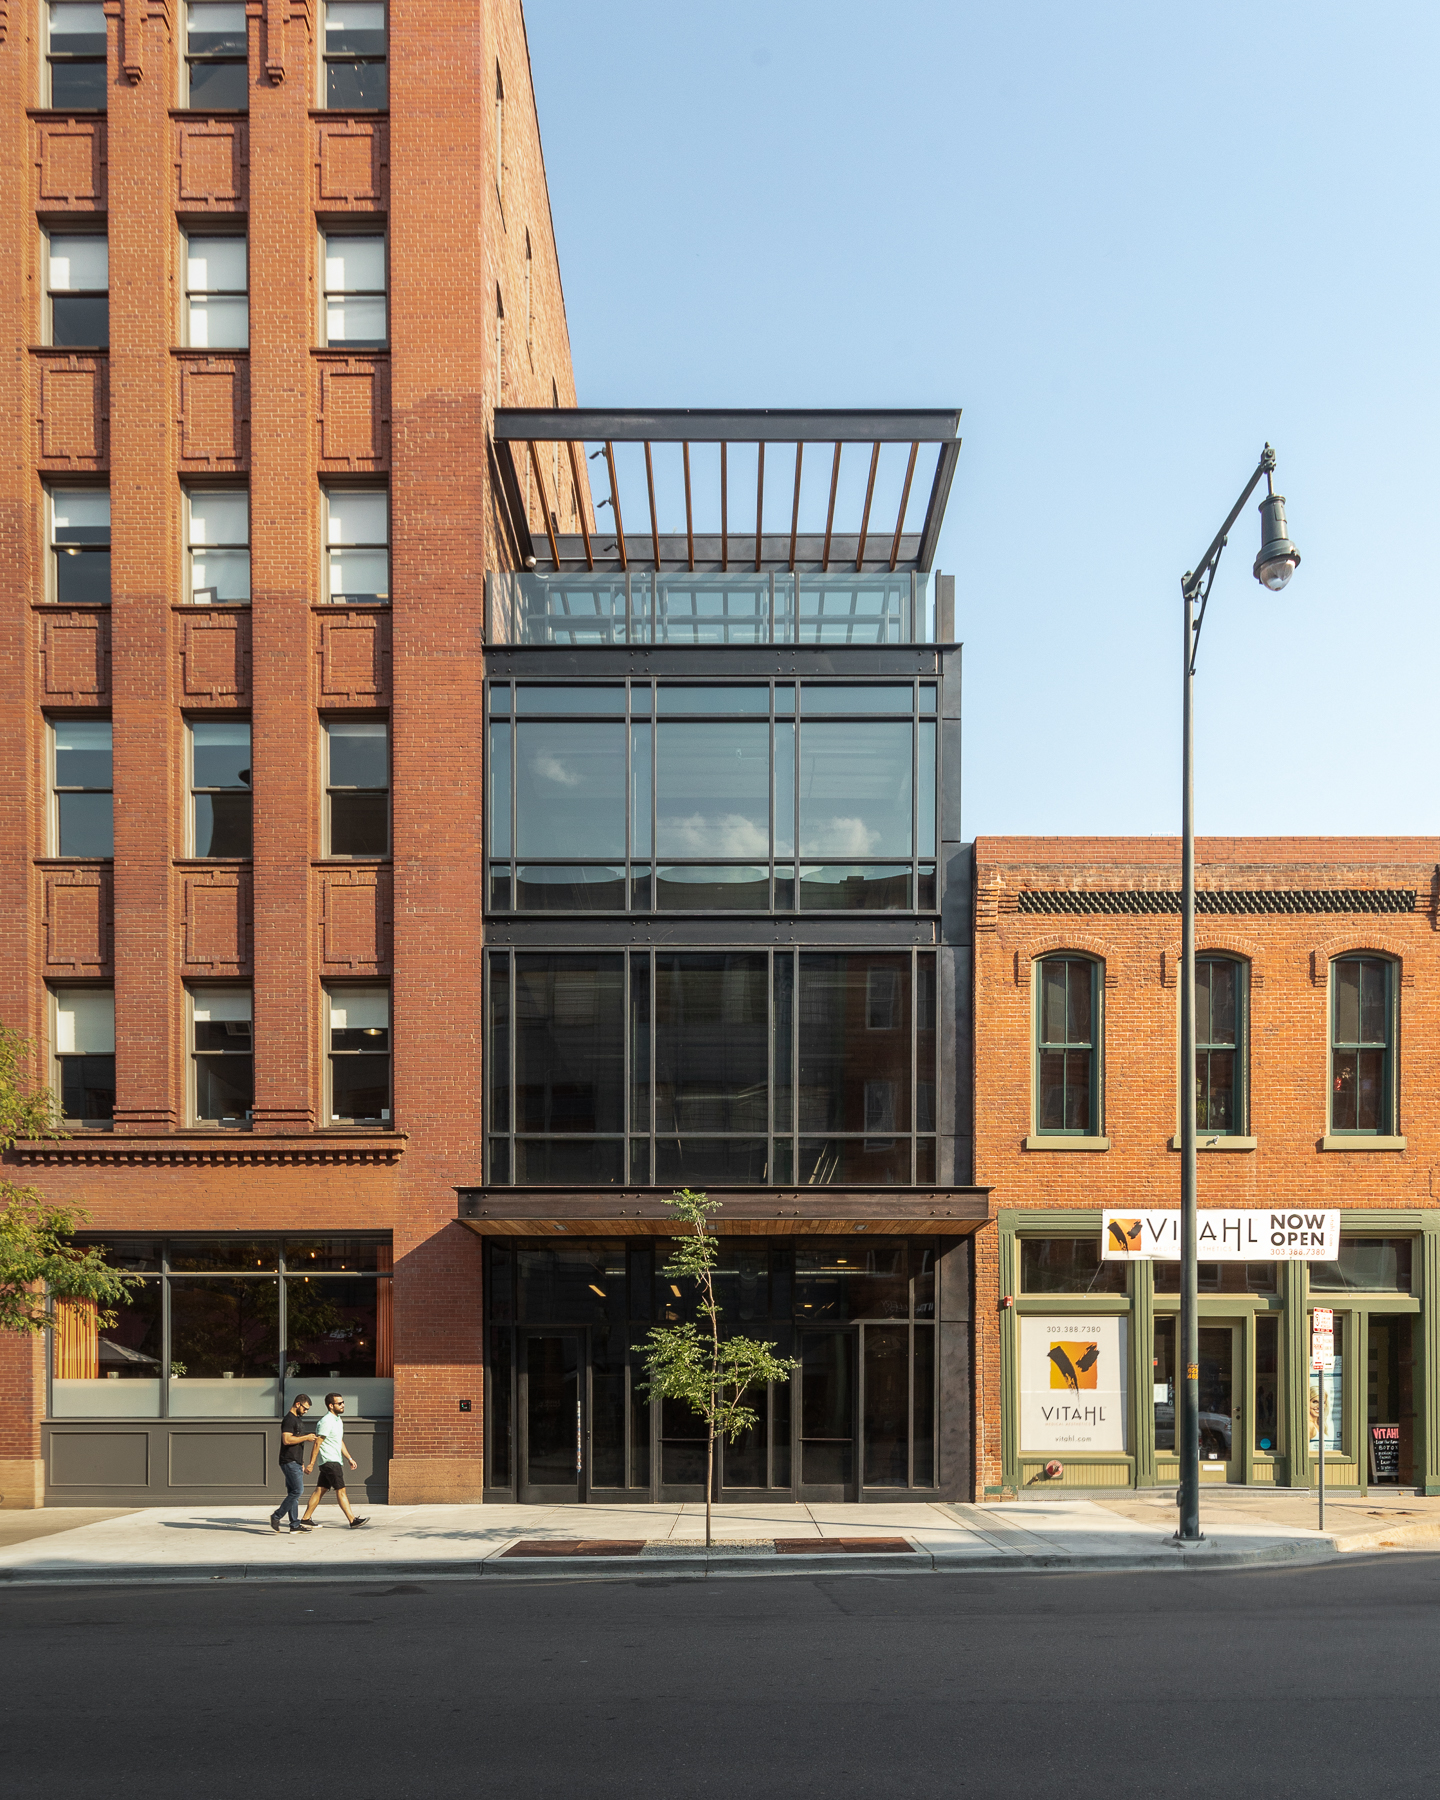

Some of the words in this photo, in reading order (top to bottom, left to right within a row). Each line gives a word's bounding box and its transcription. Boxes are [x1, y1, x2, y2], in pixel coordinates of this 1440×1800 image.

[1270, 1214, 1326, 1229] NOW
[1146, 1218, 1258, 1251] VIAHL
[1270, 1232, 1325, 1246] OPEN
[1270, 1248, 1326, 1256] 303.388.7380
[1046, 1325, 1101, 1333] 303.388.7380
[1041, 1406, 1106, 1426] VITAHL
[1055, 1434, 1092, 1442] vitahl.com
